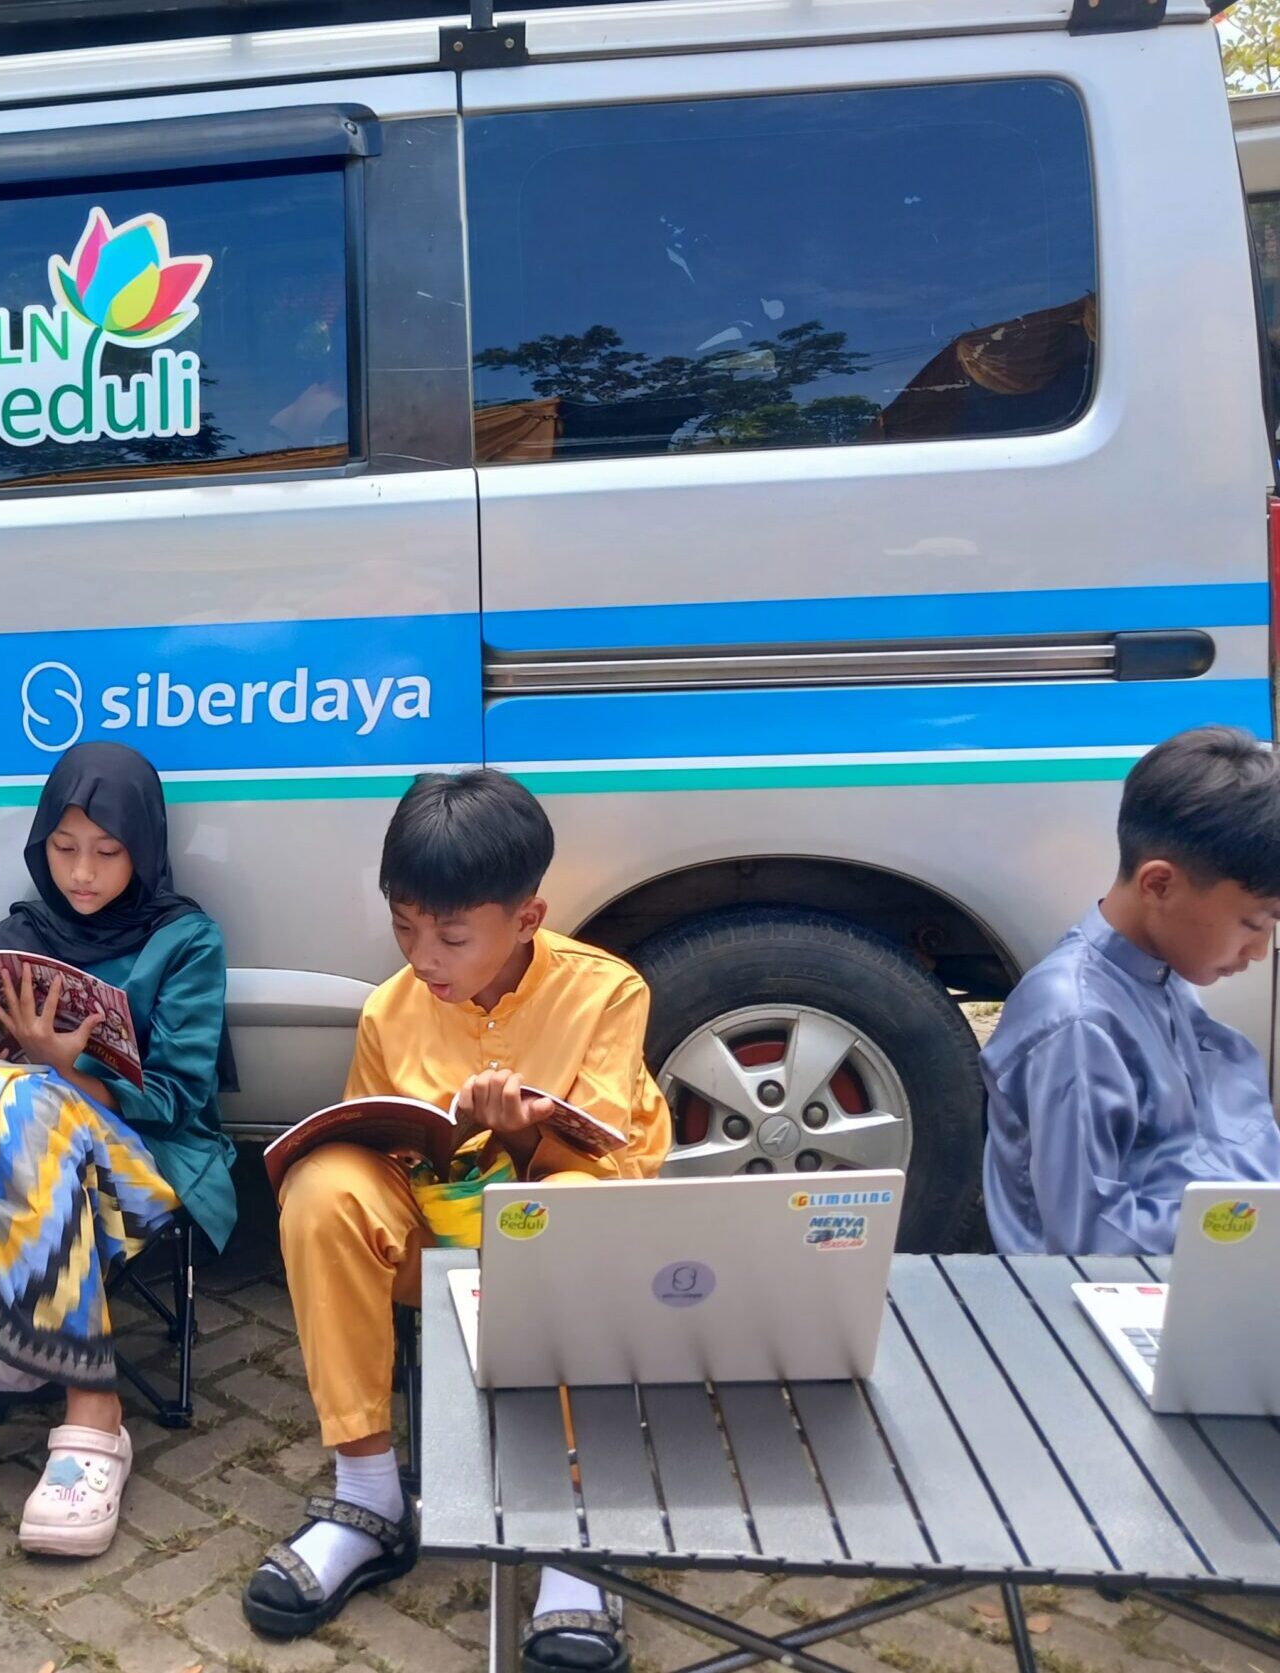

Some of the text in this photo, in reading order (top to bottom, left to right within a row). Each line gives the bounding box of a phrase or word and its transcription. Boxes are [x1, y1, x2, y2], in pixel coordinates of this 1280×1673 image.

[100, 667, 432, 736] siberdaya
[798, 1191, 891, 1206] GLIMOLING
[500, 1216, 545, 1230] Peduli
[809, 1217, 865, 1228] MENYA
[1203, 1217, 1253, 1232] Peduli
[835, 1228, 864, 1239] PA!
